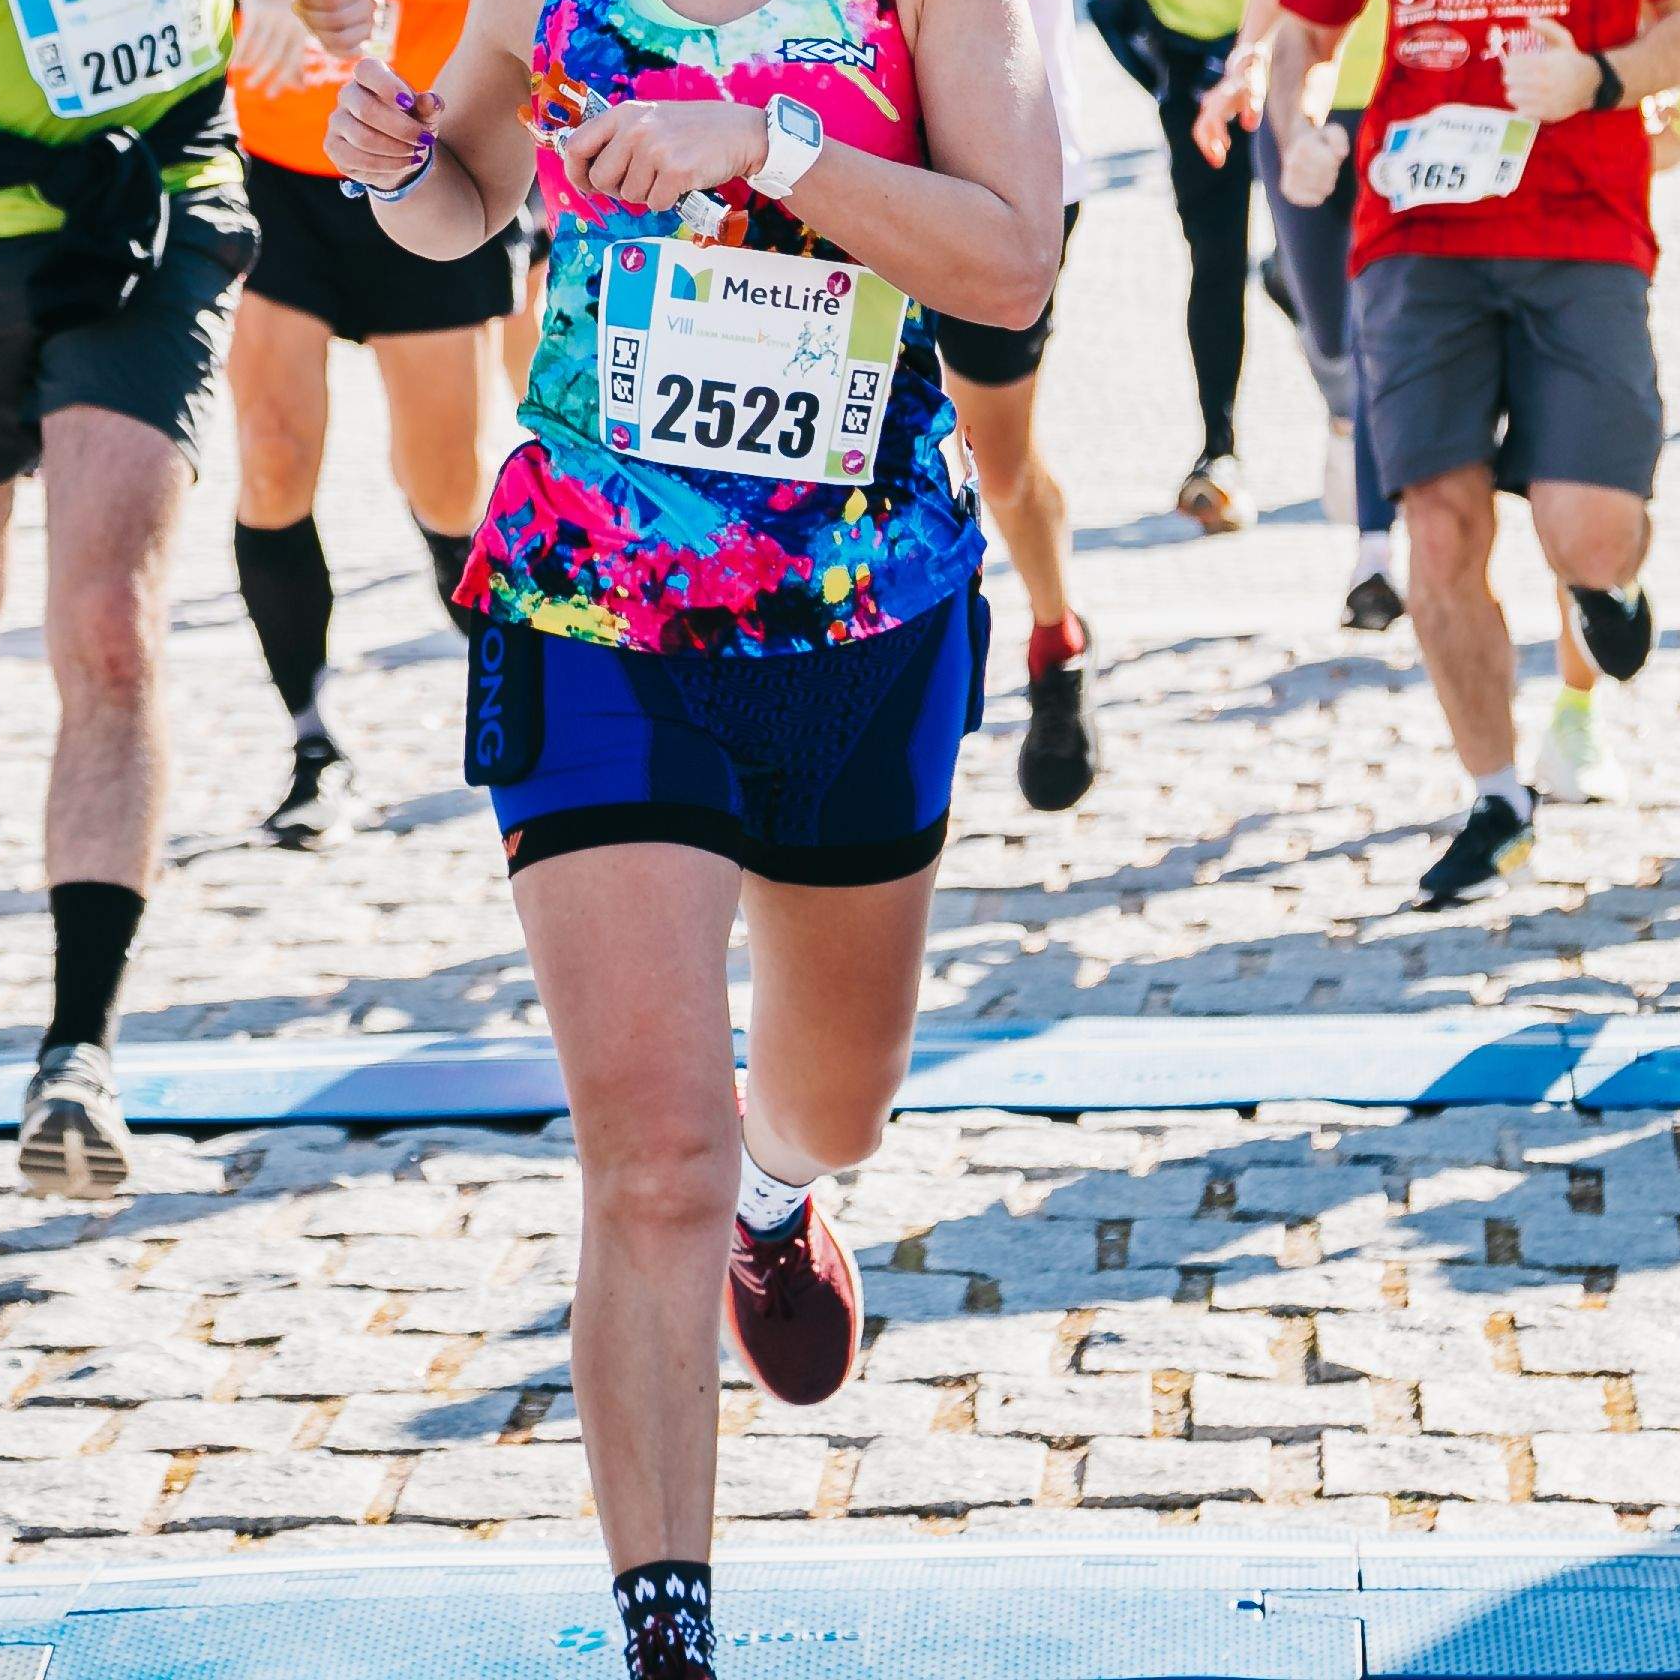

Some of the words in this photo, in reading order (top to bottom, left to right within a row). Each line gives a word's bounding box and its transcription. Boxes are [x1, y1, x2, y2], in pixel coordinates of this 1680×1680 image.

[82, 24, 182, 96] 2023
[721, 275, 841, 317] MetLife
[666, 314, 695, 336] VIII
[650, 373, 821, 460] 2523
